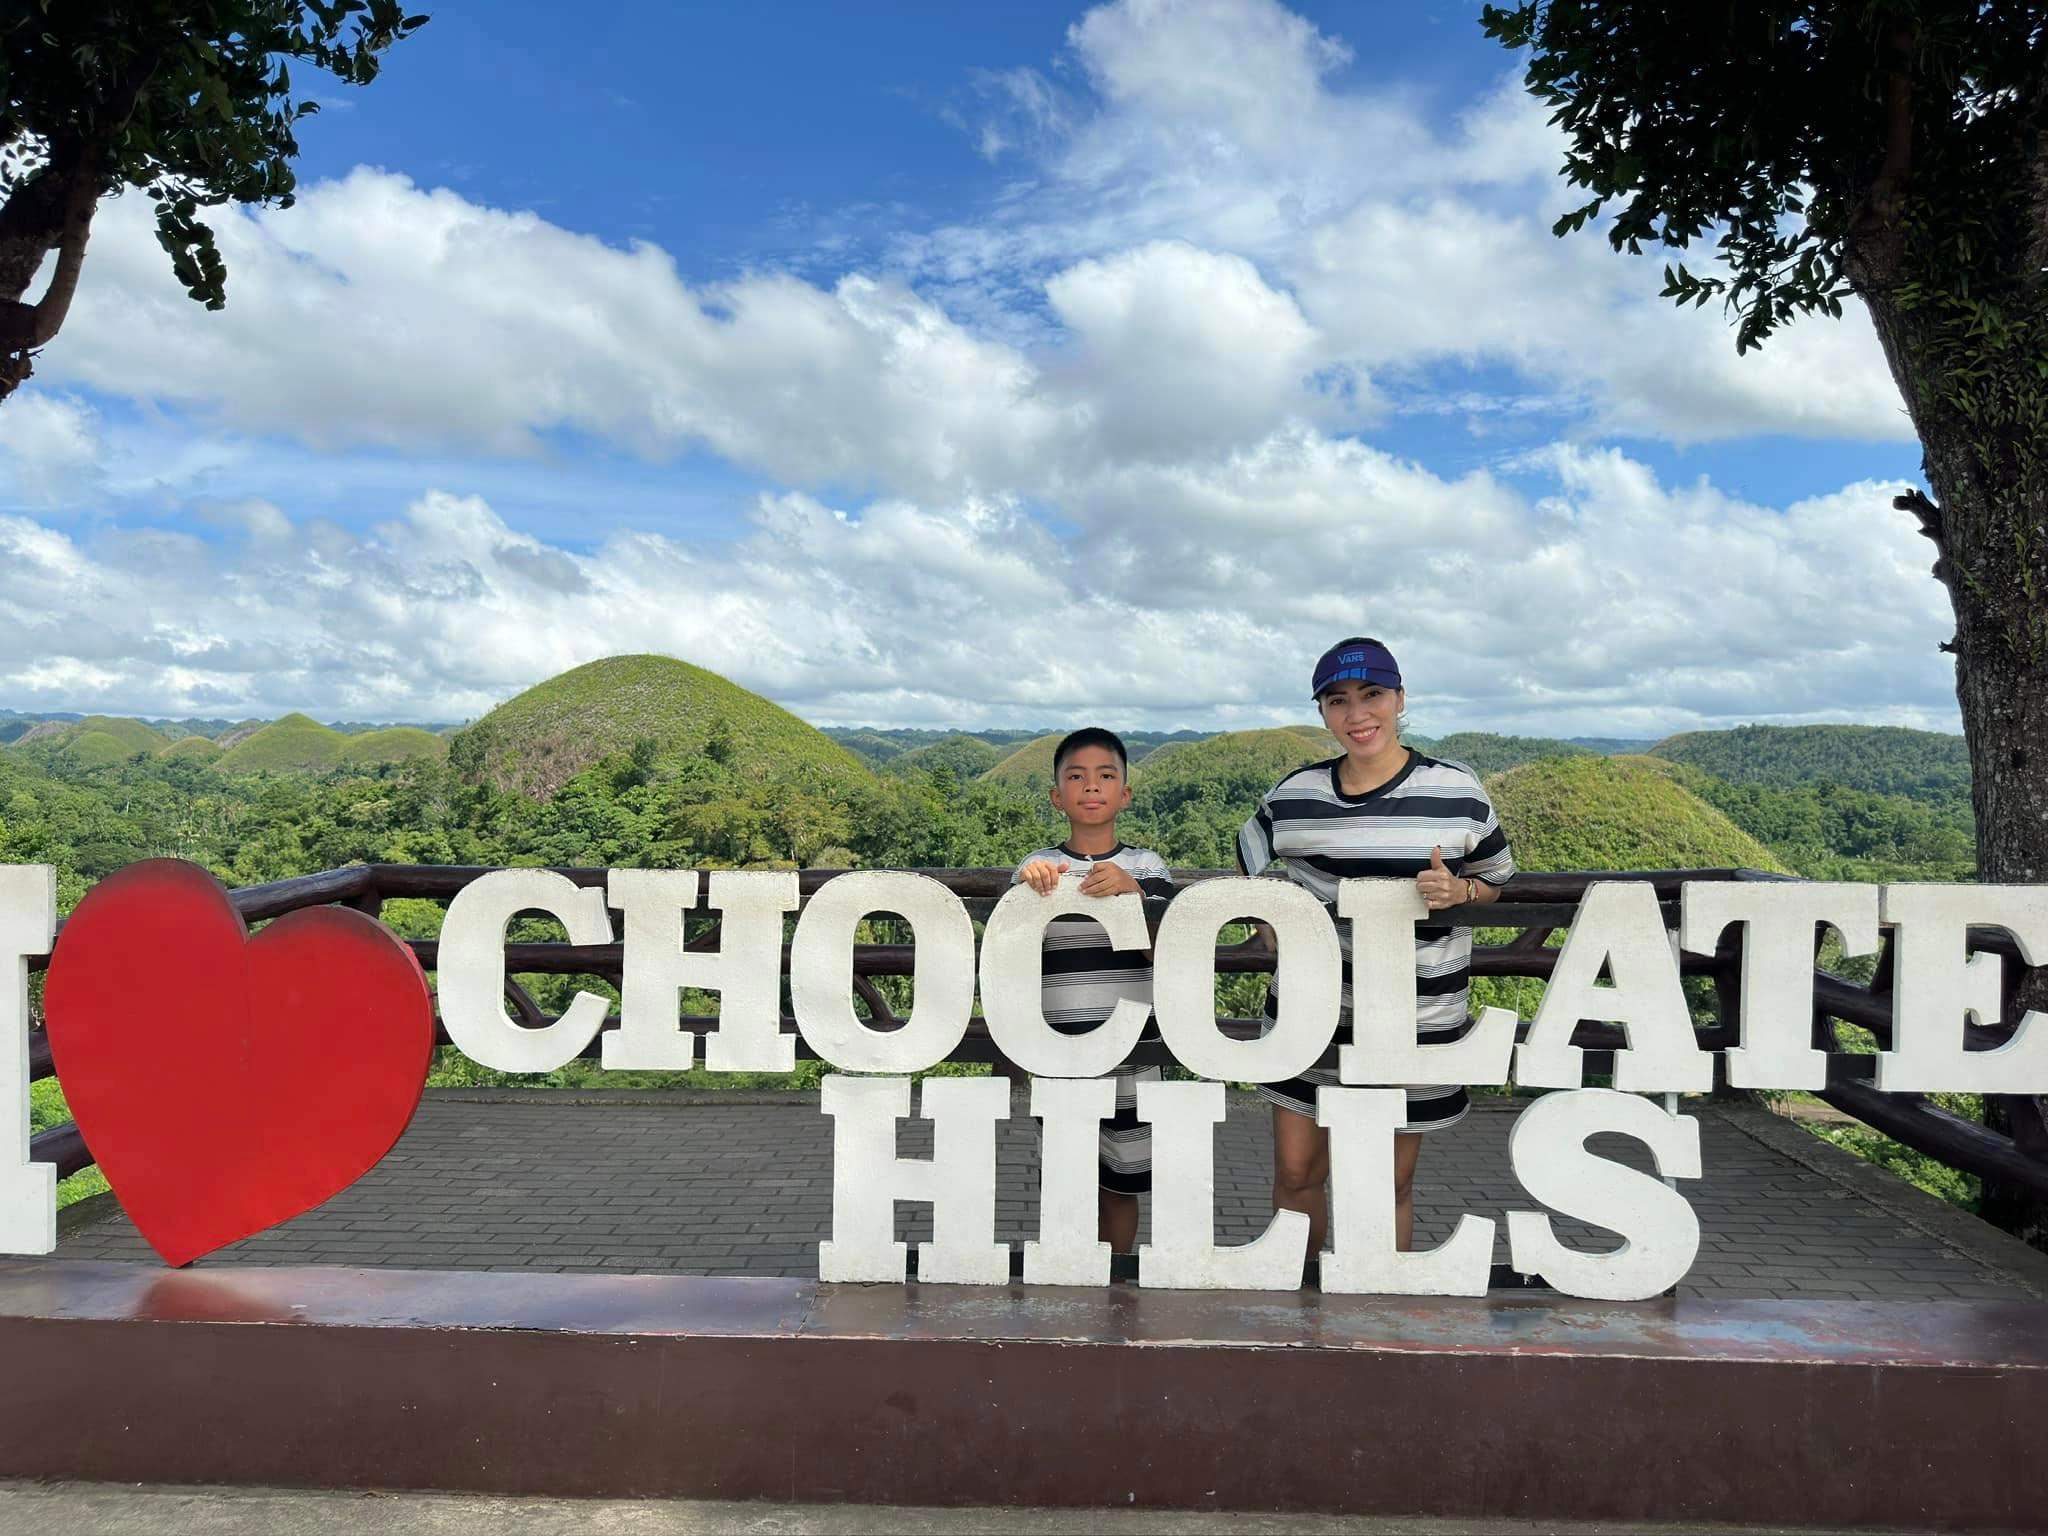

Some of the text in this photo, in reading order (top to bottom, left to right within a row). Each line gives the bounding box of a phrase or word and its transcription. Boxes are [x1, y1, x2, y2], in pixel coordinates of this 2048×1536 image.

[1337, 651, 1366, 665] VANS
[437, 867, 2048, 1094] CHOCOLATE
[819, 1075, 1703, 1301] HILLS
